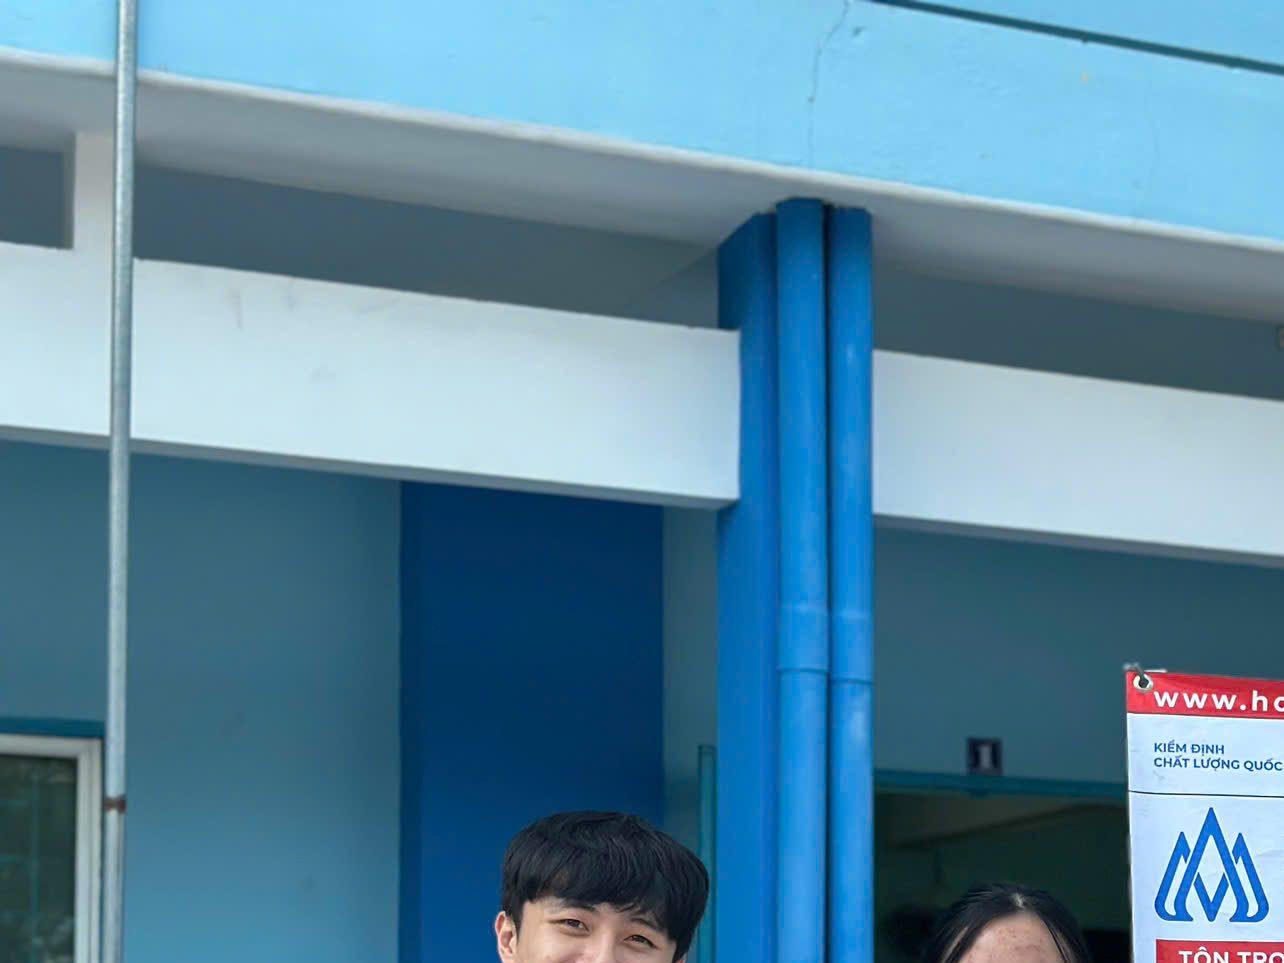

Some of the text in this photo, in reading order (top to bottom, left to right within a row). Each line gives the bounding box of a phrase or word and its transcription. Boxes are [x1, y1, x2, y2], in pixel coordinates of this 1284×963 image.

[1154, 741, 1224, 756] KIỂM ĐỊNH
[1153, 756, 1190, 768] CHẤT
[1193, 757, 1240, 771] LƯỢNG
[1243, 759, 1282, 772] QUỐC
